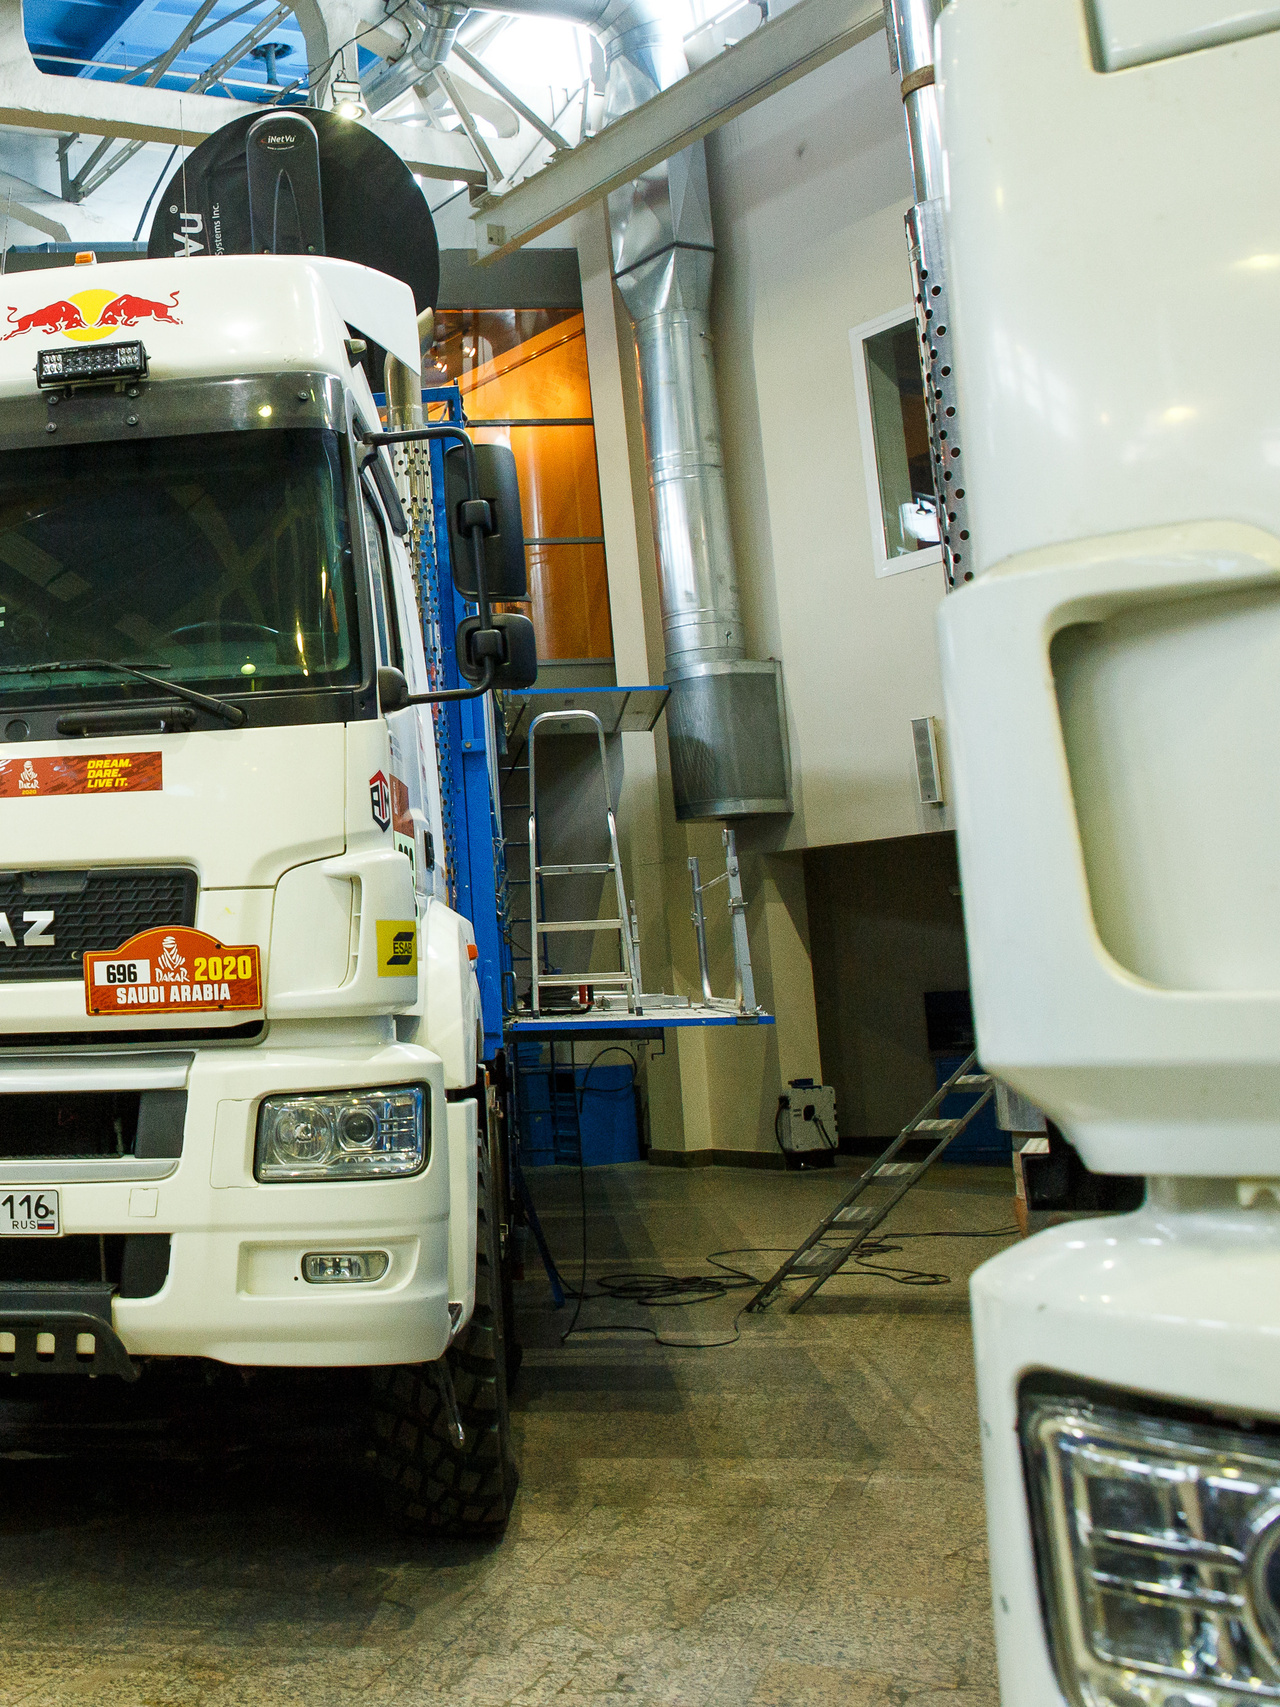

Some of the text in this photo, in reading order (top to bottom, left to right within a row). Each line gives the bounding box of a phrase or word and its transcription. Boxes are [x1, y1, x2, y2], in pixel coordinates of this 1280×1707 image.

[87, 759, 132, 769] DREAM.
[87, 769, 122, 778] DARE.
[87, 778, 128, 788] LIVE IT.
[106, 963, 138, 983] 696
[194, 955, 252, 981] 2020
[116, 983, 231, 1004] SAUDI ARABIA
[1, 1194, 50, 1219] 116
[12, 1220, 37, 1230] RUS
